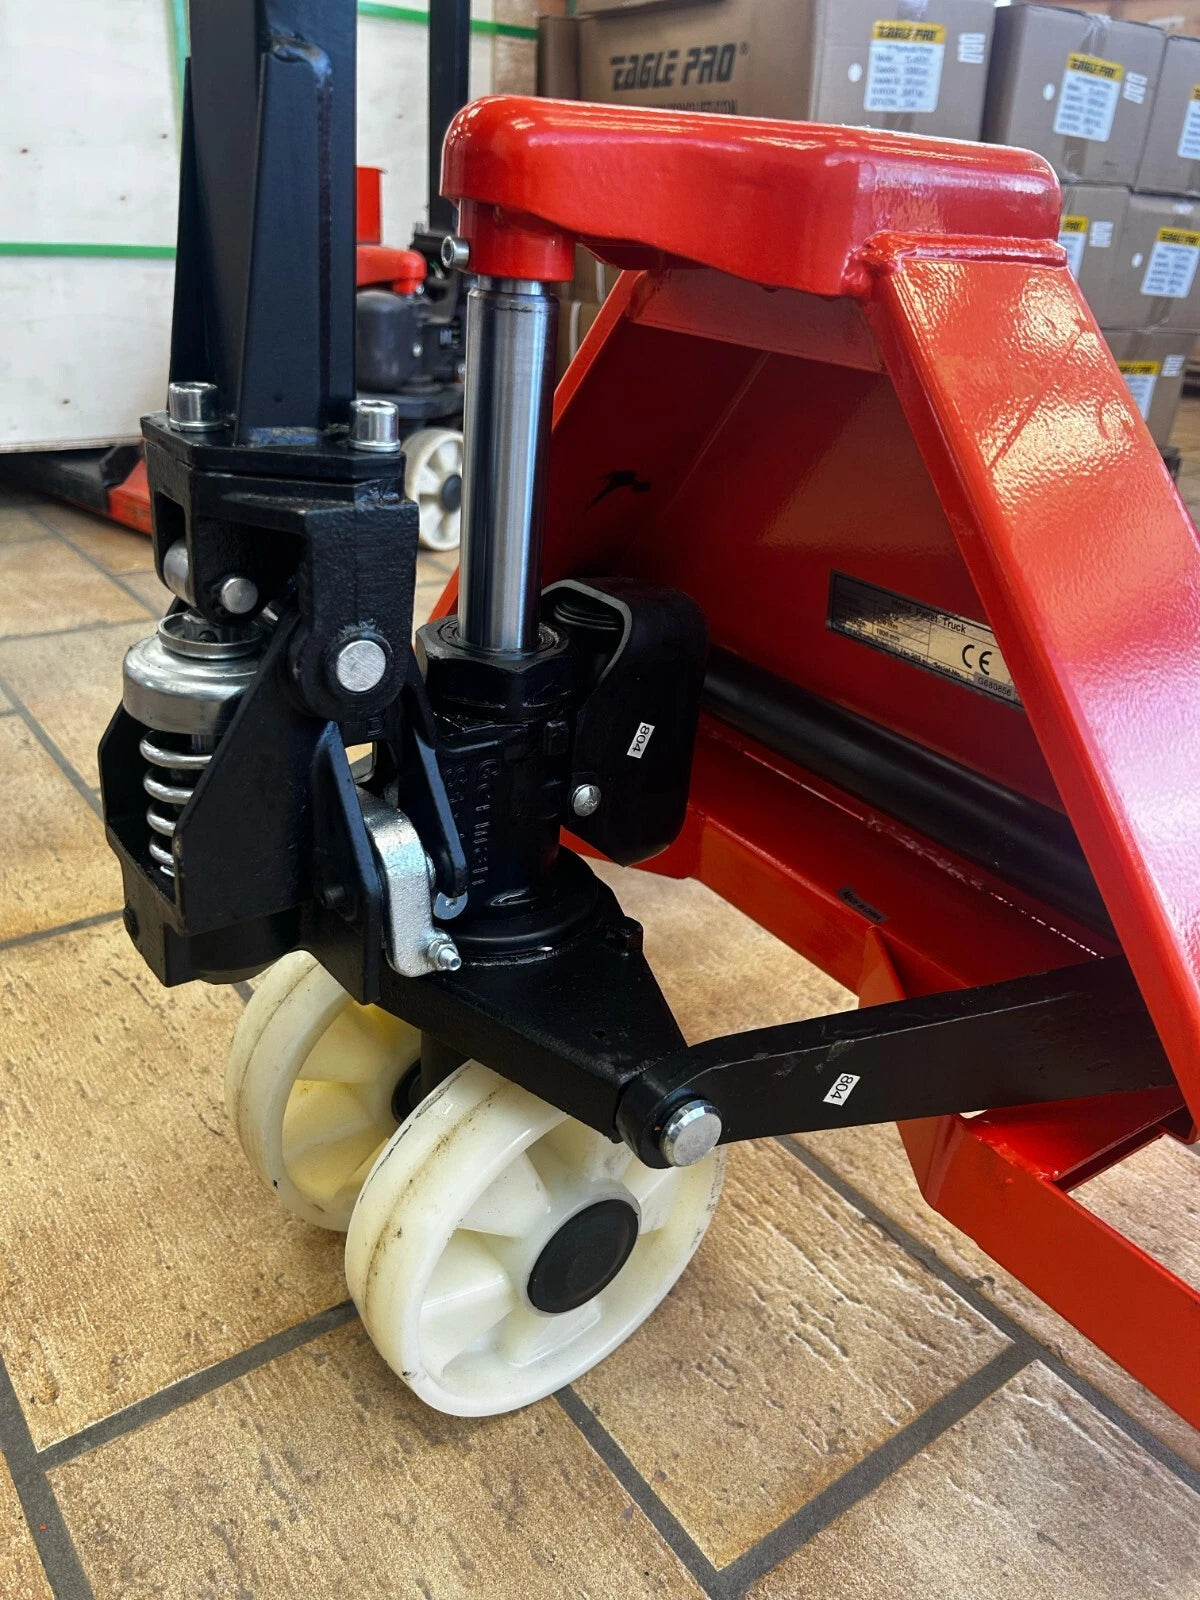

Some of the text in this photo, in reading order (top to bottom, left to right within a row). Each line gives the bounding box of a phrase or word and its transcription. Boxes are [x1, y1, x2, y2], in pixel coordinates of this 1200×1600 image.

[609, 43, 737, 91] EAGLE PRO
[942, 617, 967, 634] Truck
[962, 644, 992, 676] CE
[631, 725, 651, 752] 804
[830, 1075, 854, 1099] 804
